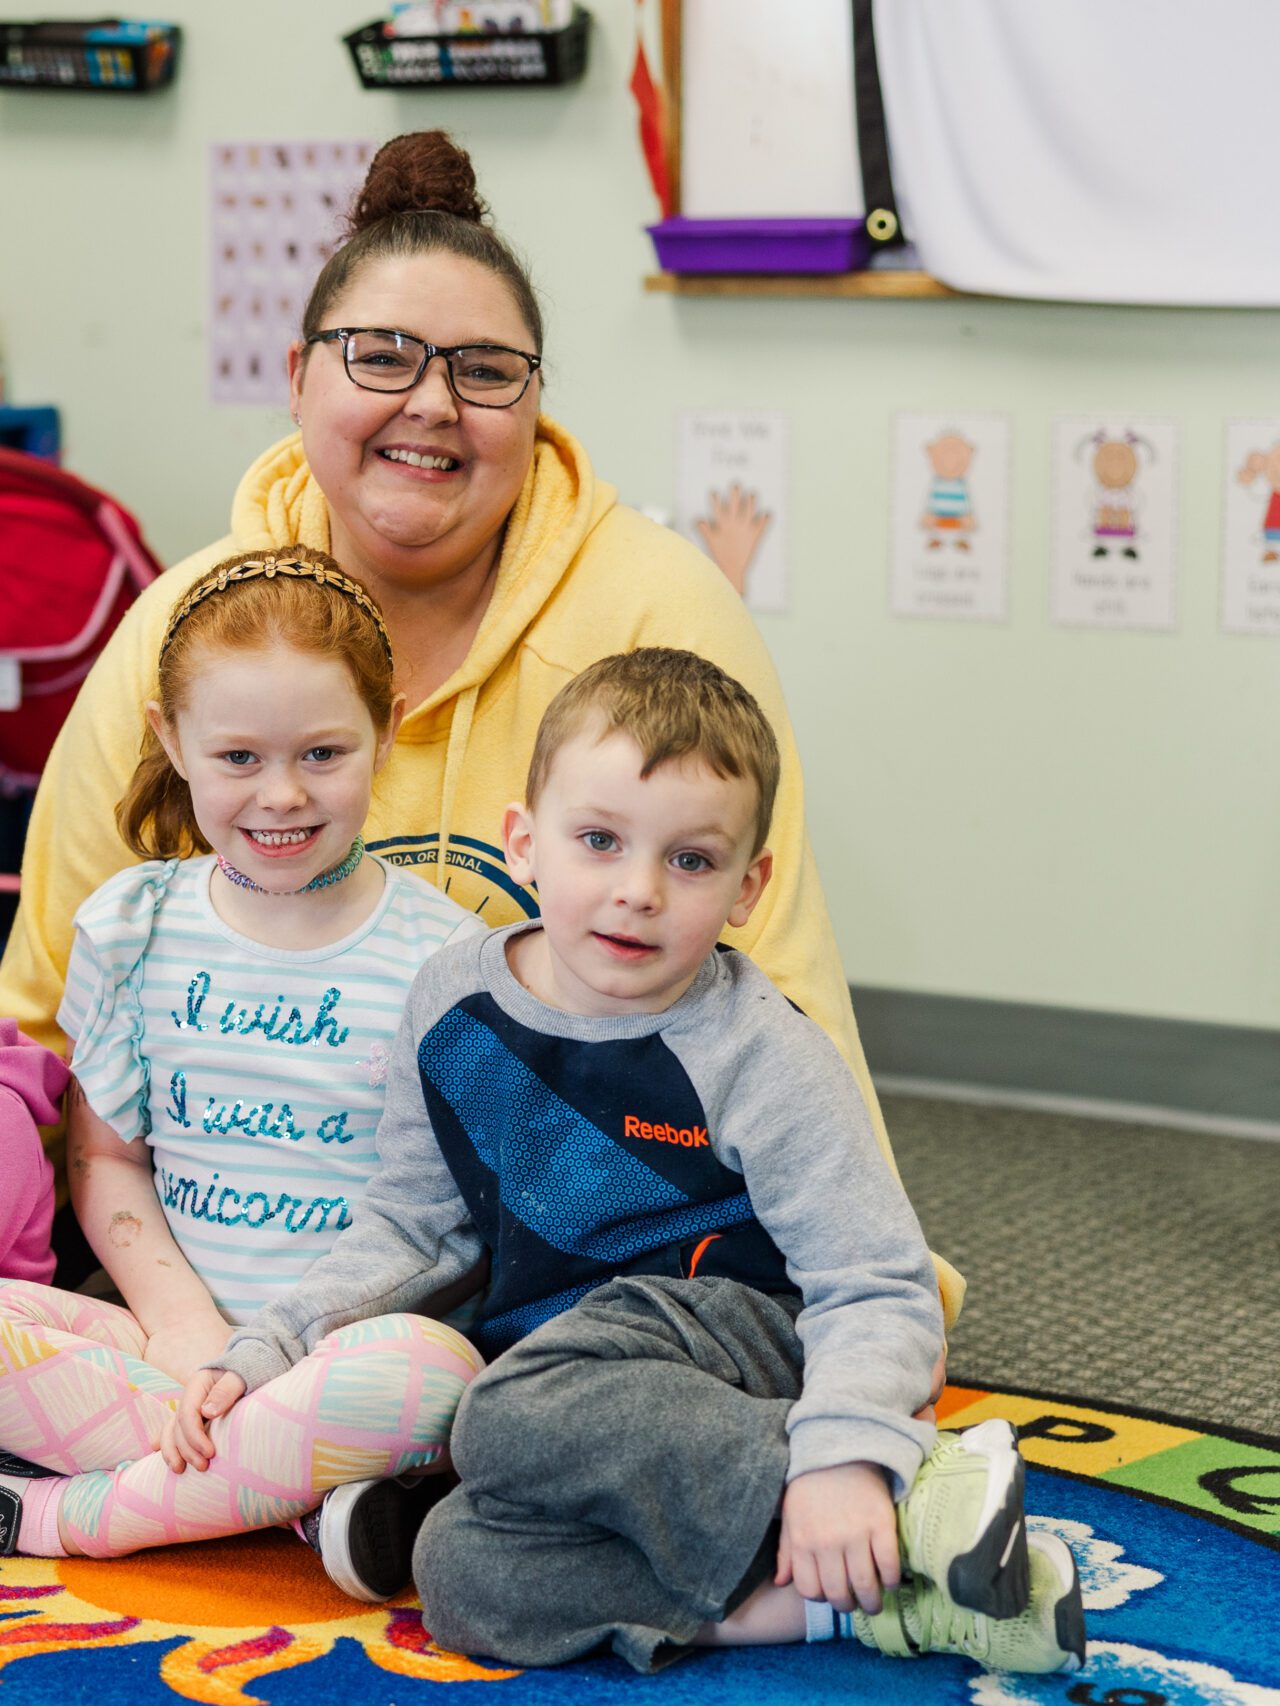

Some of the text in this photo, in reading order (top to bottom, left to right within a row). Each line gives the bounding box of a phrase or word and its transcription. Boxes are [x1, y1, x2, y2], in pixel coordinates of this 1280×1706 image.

[417, 850, 483, 873] ORGINAL
[171, 971, 349, 1047] I wish
[166, 1071, 354, 1143] I was a
[624, 1115, 710, 1148] Reebok
[161, 1168, 353, 1232] unicorn
